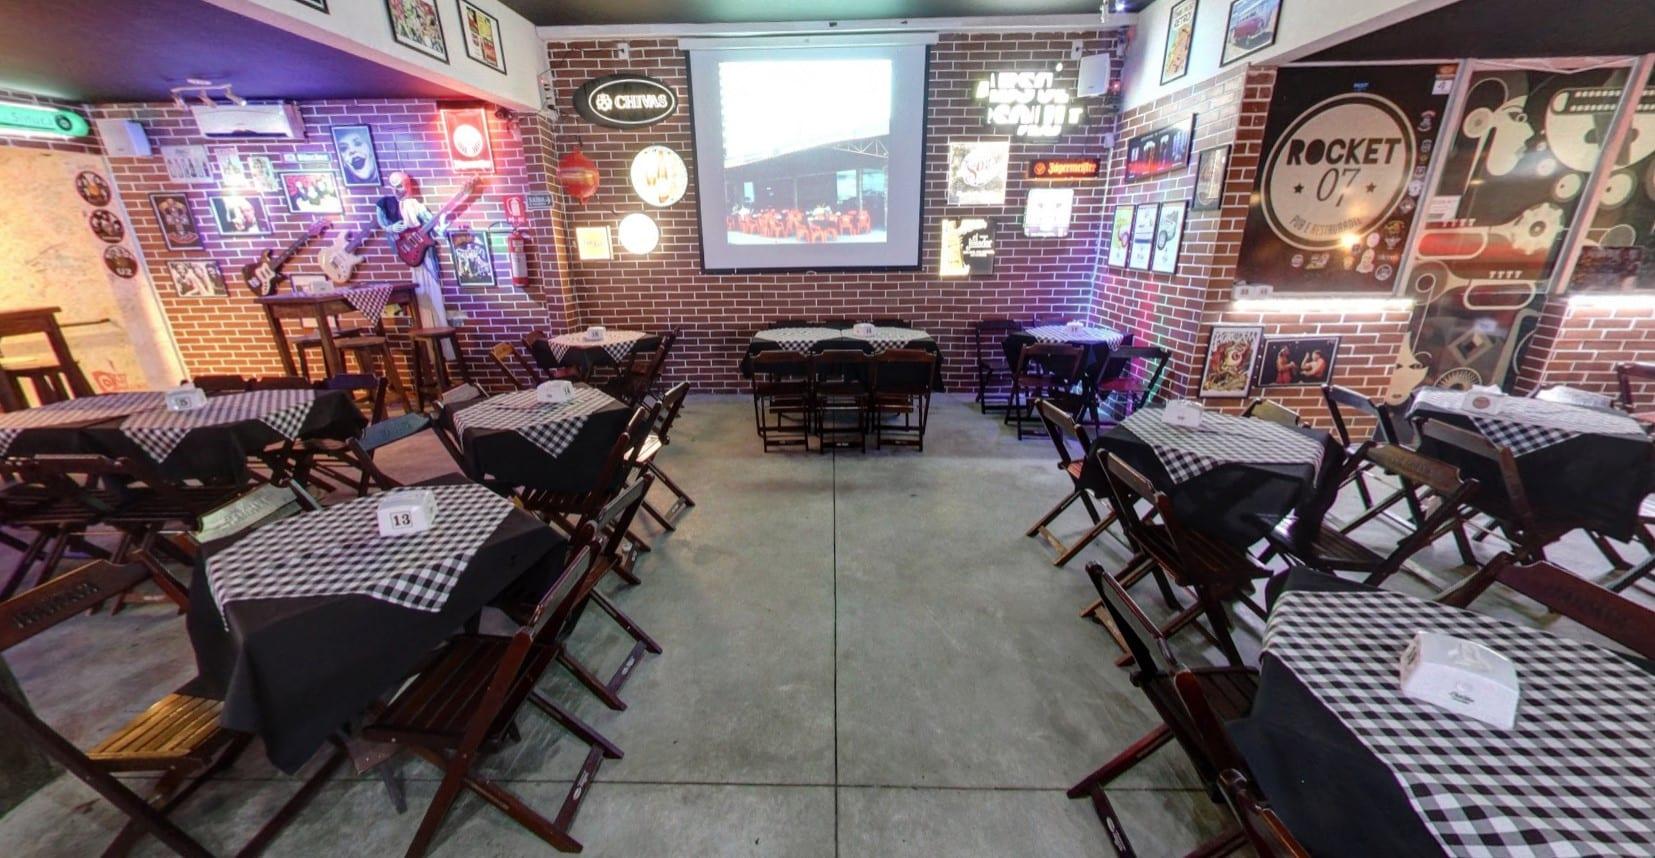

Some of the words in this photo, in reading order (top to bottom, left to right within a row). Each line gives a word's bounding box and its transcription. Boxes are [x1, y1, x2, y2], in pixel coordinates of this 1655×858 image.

[614, 94, 668, 109] CHIVAS
[1286, 138, 1402, 165] ROCKET
[1316, 168, 1361, 207] 07
[393, 513, 411, 526] 13
